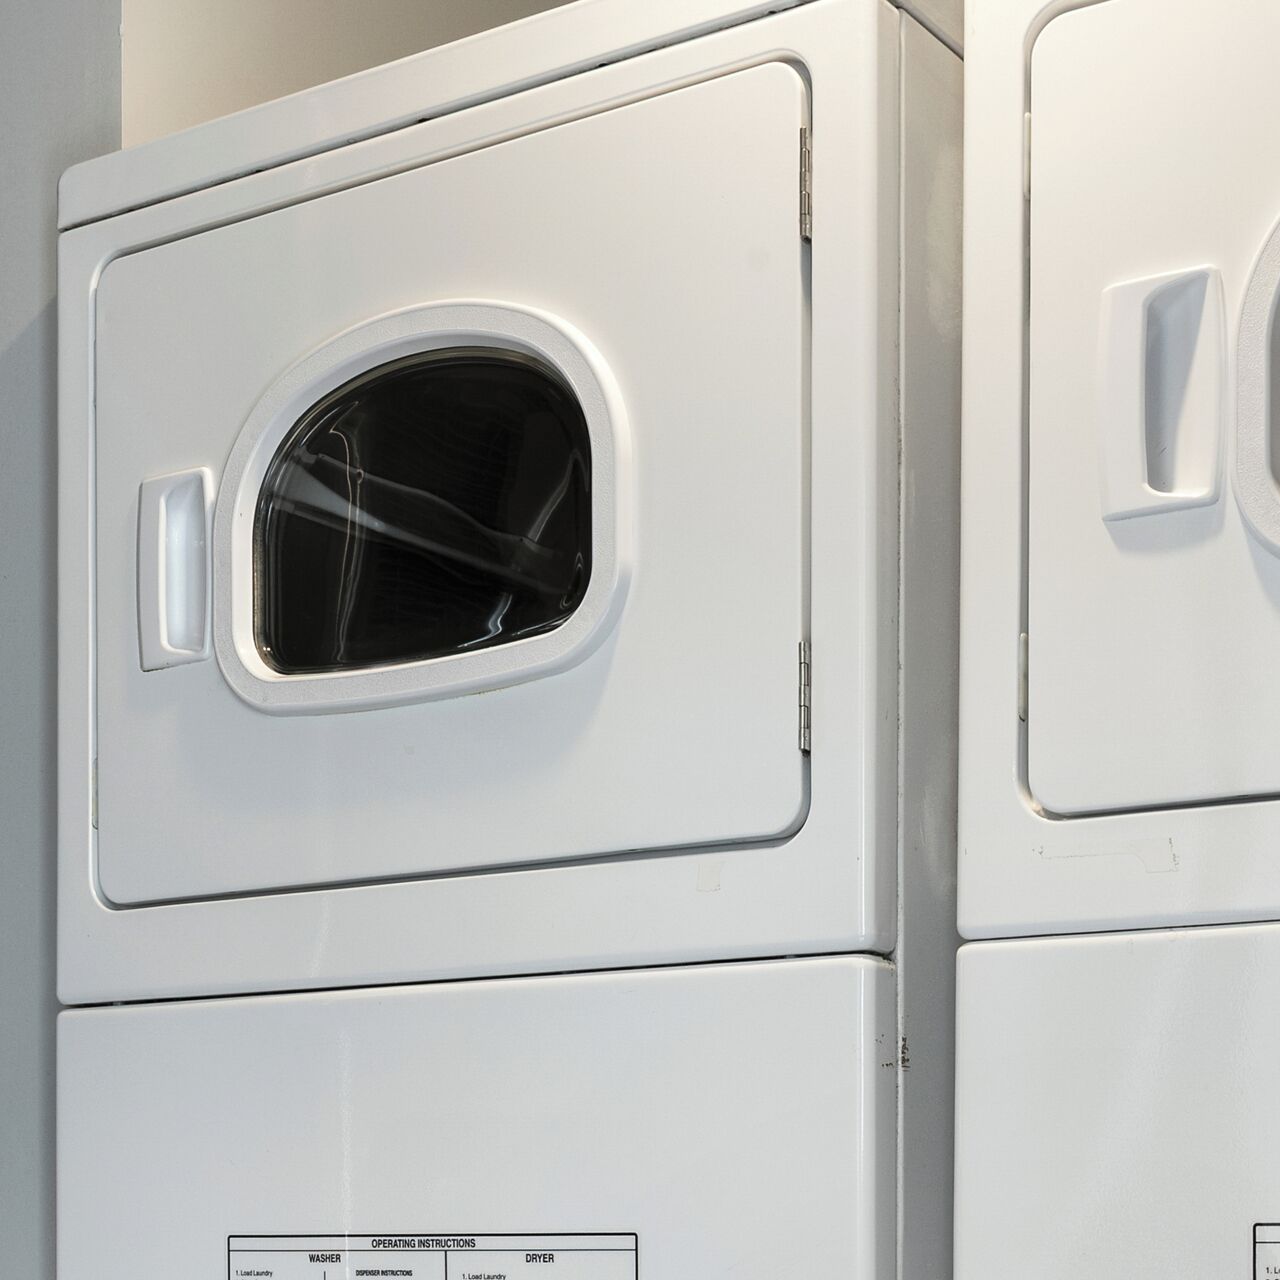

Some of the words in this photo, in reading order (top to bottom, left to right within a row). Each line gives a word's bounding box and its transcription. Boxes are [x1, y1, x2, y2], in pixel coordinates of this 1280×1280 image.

[371, 1239, 416, 1248] OPERATING
[418, 1239, 476, 1248] INSTRUCTIONS
[309, 1254, 341, 1263] WASHER
[526, 1254, 554, 1263] DRYER
